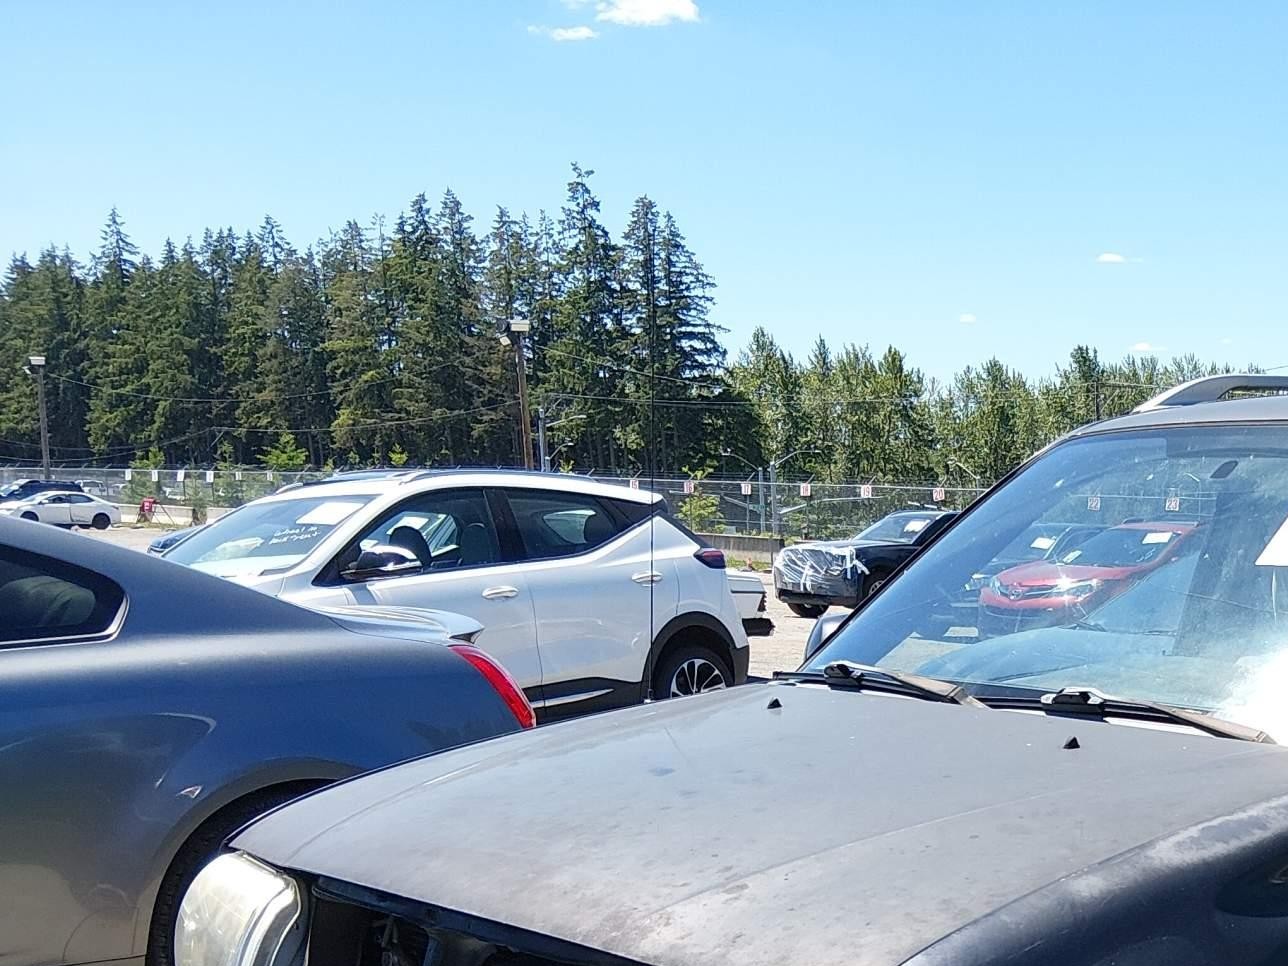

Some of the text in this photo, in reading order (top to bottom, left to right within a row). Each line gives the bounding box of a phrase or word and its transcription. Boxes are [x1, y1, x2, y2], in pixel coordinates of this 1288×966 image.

[934, 489, 944, 500] 20
[1089, 497, 1100, 510] 22
[1167, 498, 1178, 510] 23
